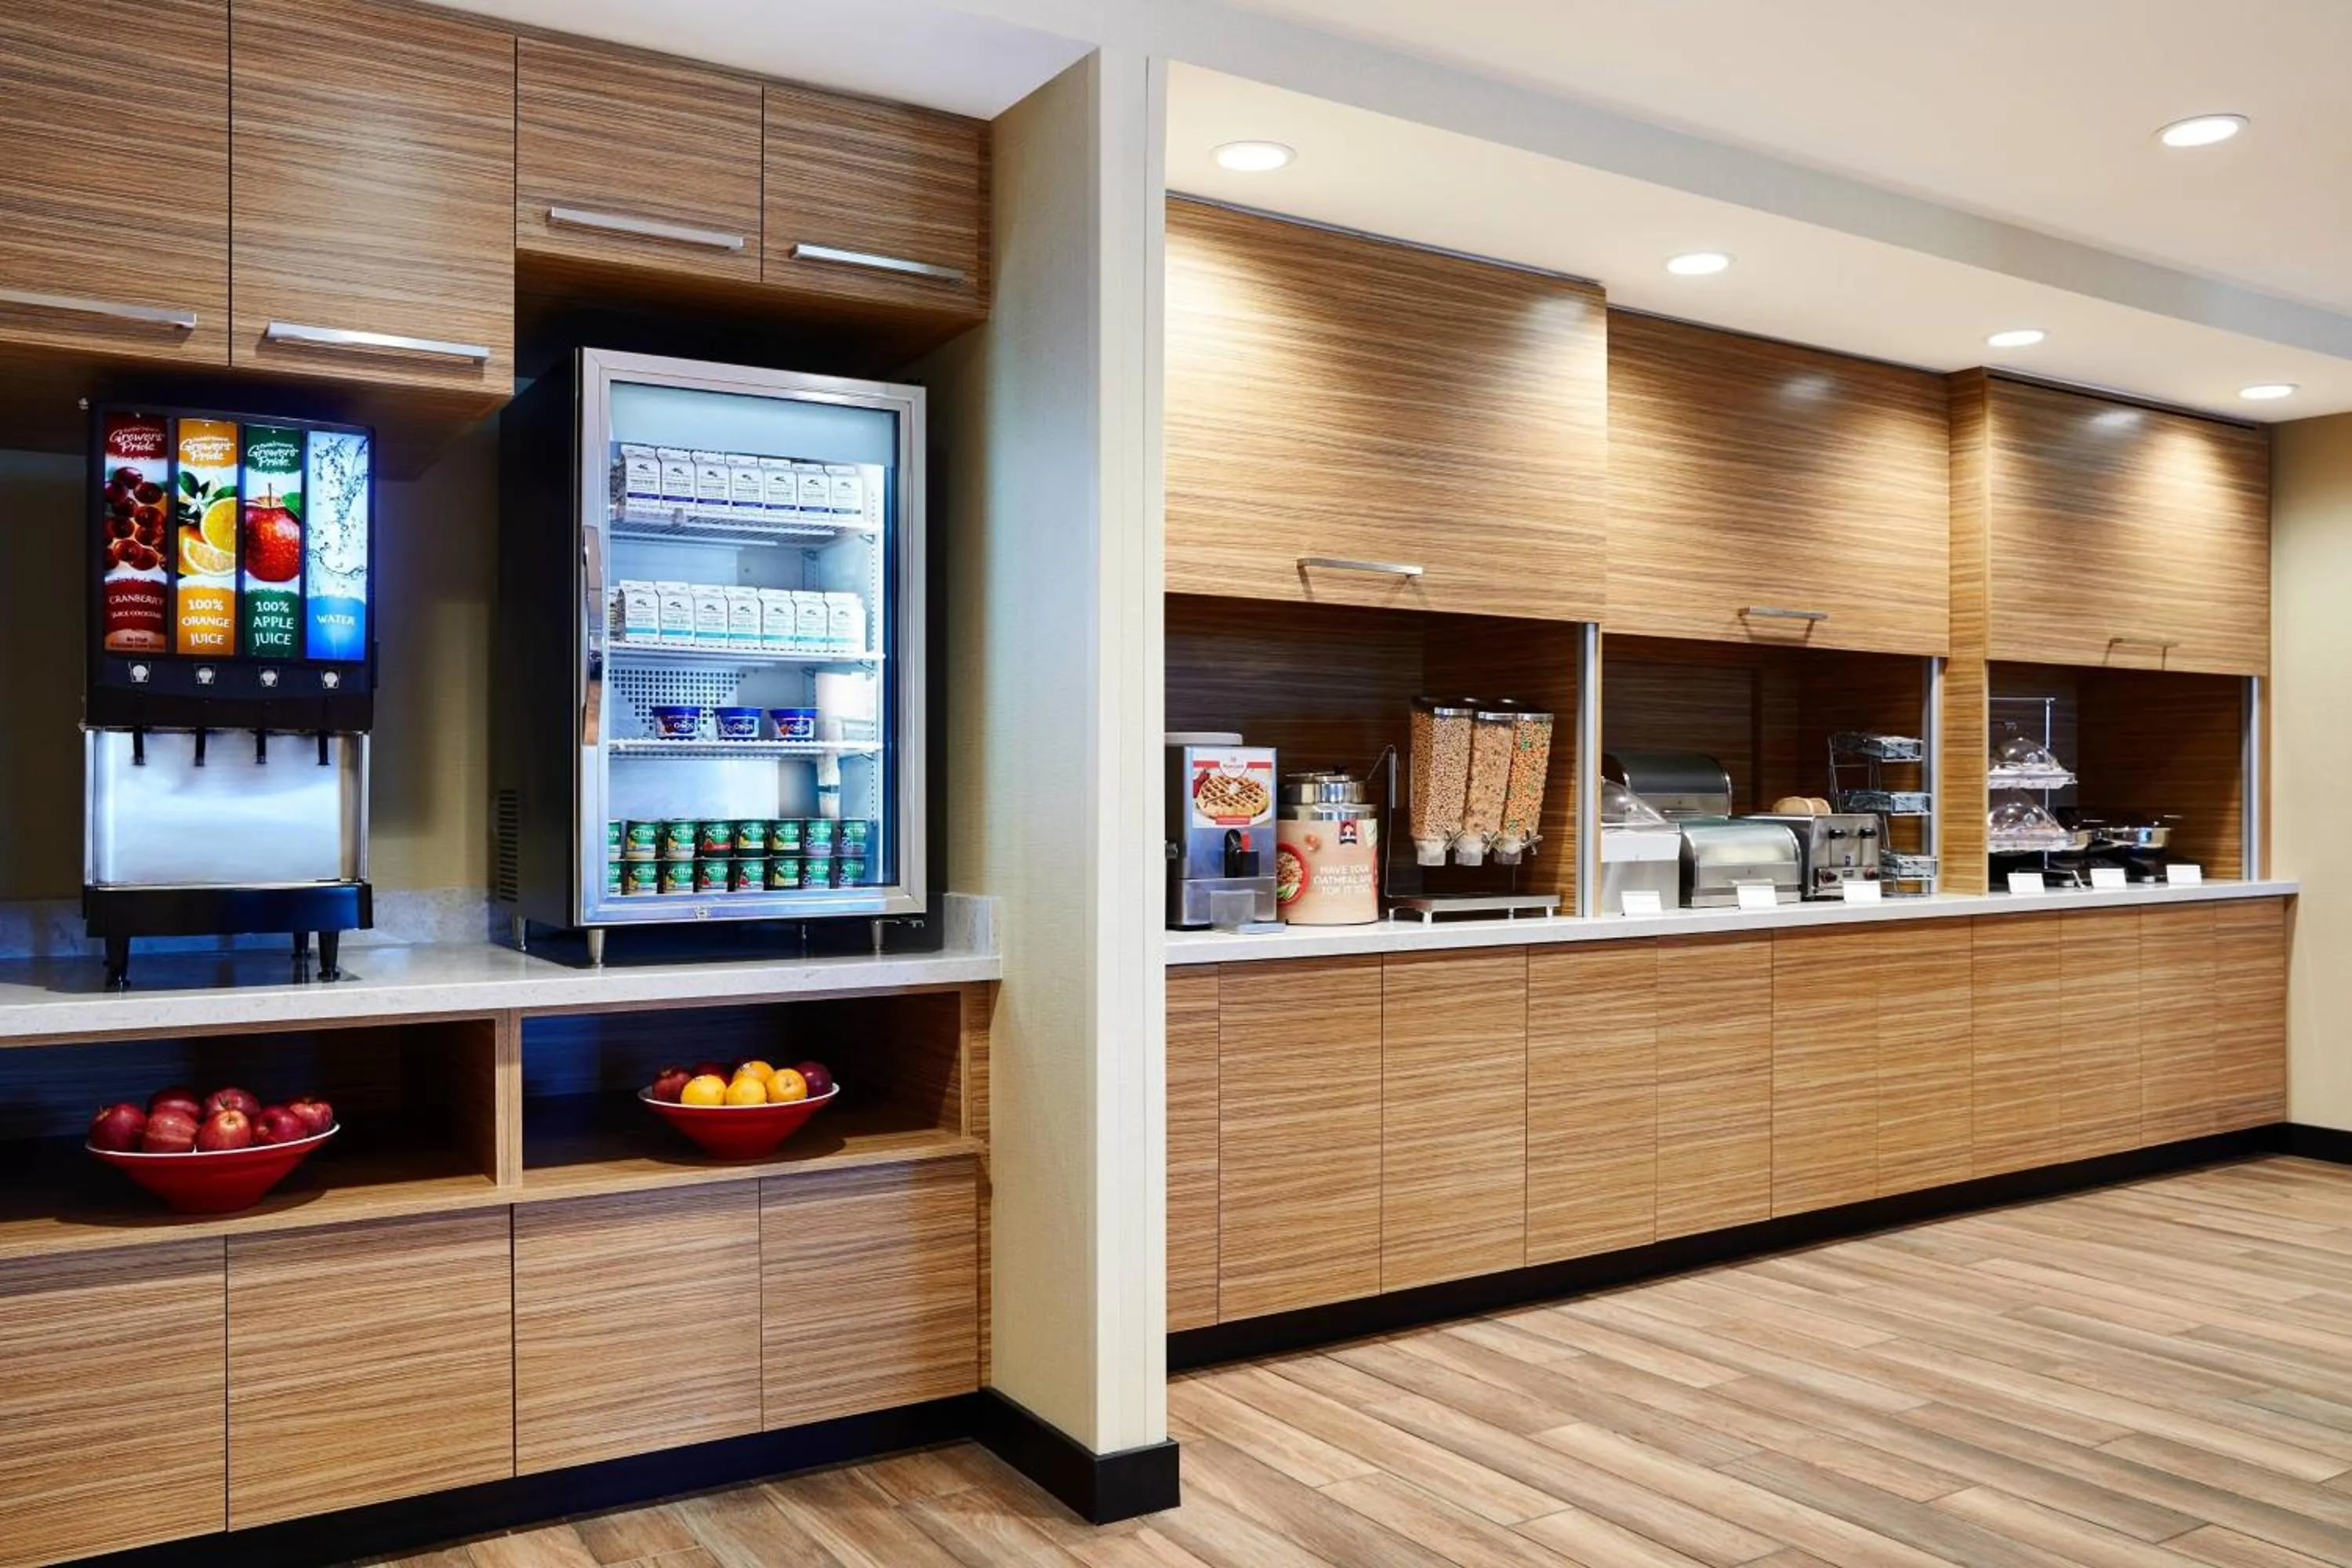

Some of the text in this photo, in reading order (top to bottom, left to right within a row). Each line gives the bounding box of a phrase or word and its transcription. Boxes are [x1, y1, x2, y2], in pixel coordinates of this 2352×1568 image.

[119, 441, 155, 453] Pride
[109, 593, 164, 605] CRANBERRY
[187, 598, 223, 611] 100%
[255, 601, 289, 613] 100%
[182, 615, 230, 628] ORANGE
[253, 615, 294, 630] APPLE
[316, 614, 356, 626] WATER
[191, 633, 225, 646] JUICE
[255, 633, 292, 647] JUICE
